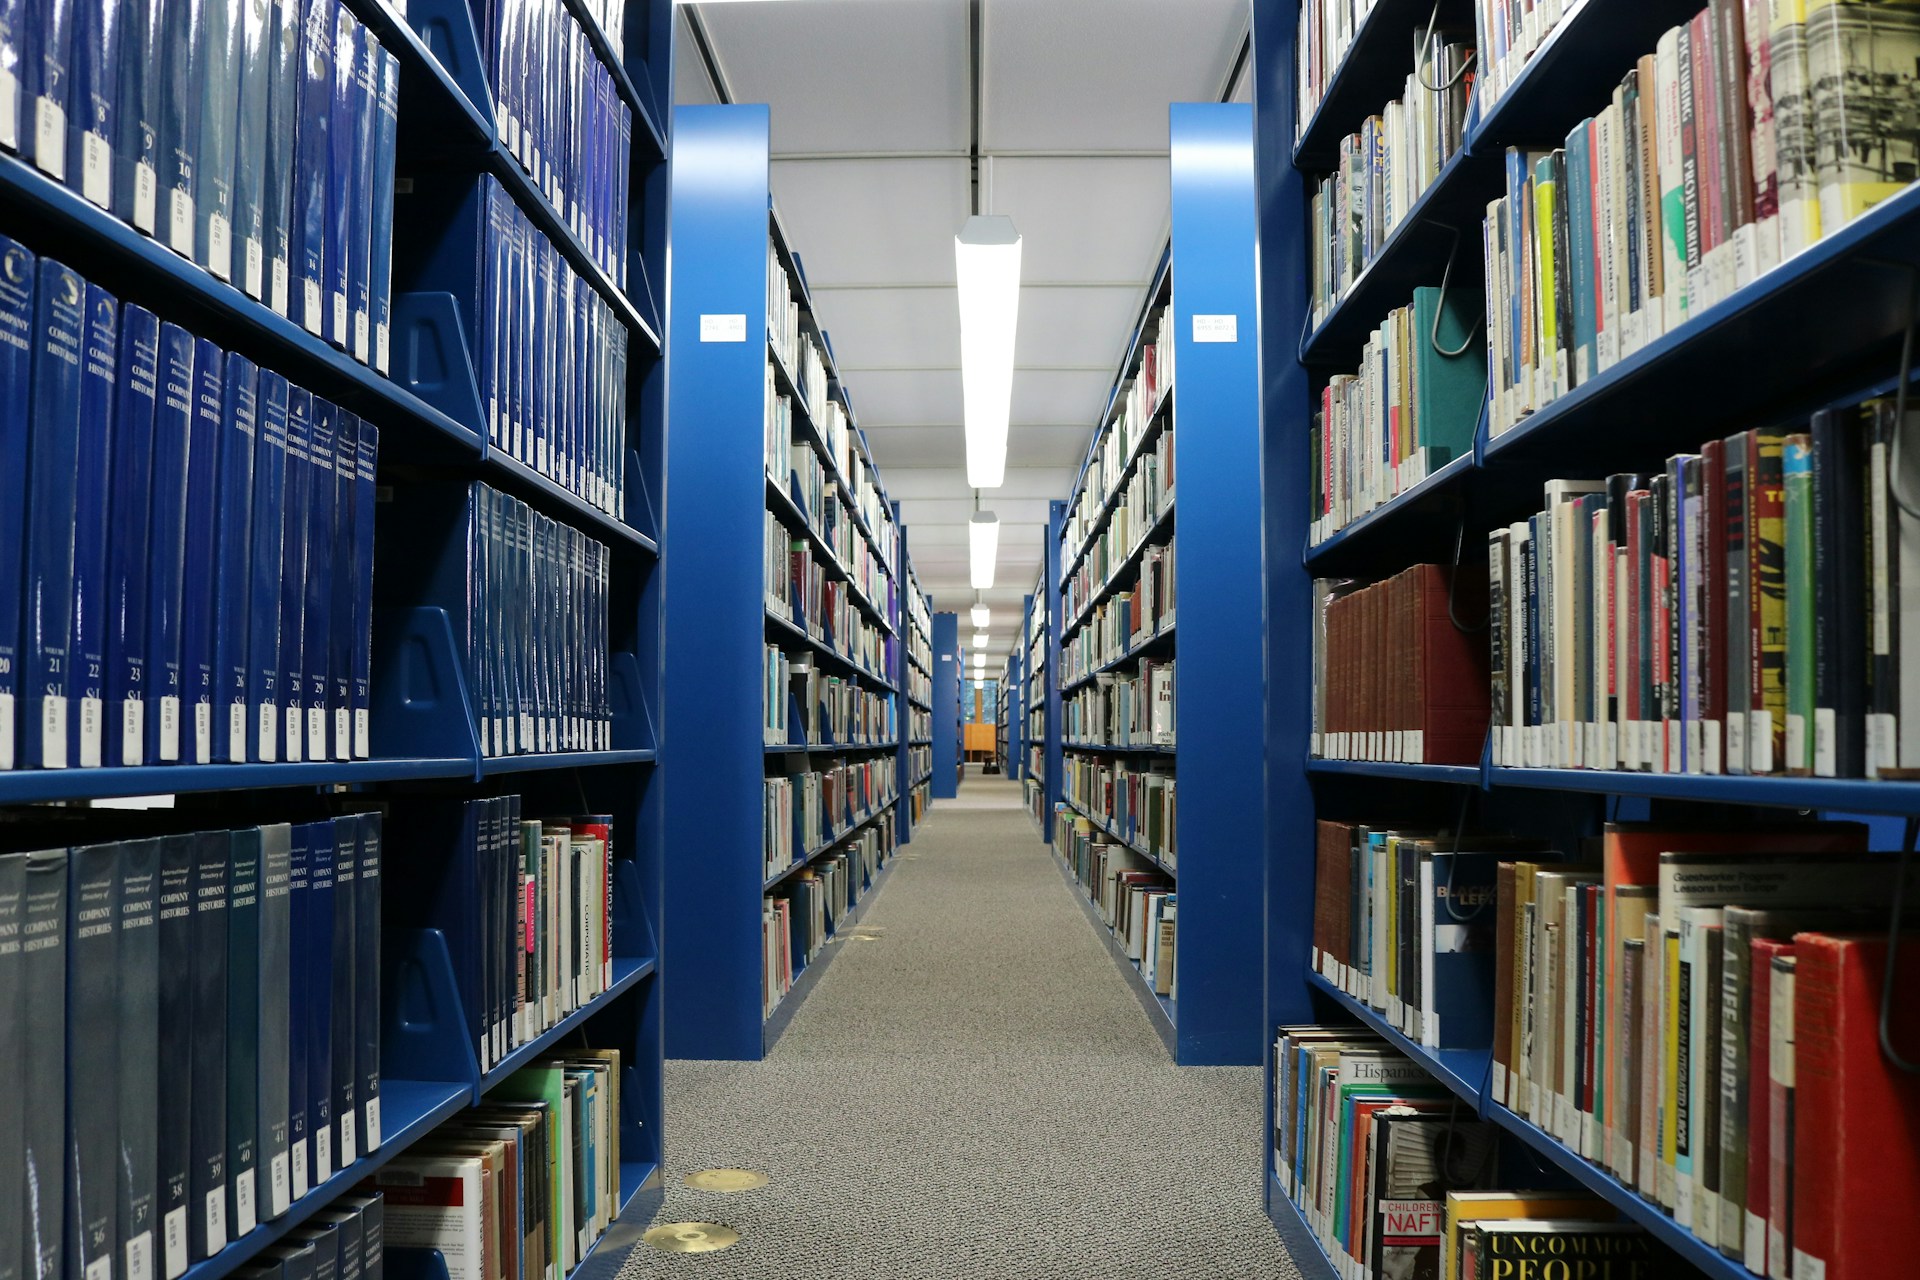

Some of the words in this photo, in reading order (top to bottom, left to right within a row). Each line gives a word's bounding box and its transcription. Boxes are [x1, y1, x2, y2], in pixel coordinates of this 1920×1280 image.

[1679, 33, 1692, 122] PICTURING
[98, 105, 106, 122] 8
[145, 133, 154, 150] 9
[1755, 105, 1770, 194] MACHINE
[178, 162, 191, 179] 10
[1643, 148, 1652, 208] DYNAMICS
[1384, 147, 1392, 227] REUTHER
[218, 191, 227, 206] 11
[253, 213, 261, 228] 12
[1684, 159, 1698, 267] PROLETARIAT
[308, 258, 317, 271] 14
[1647, 229, 1655, 297] DOMINATIO
[360, 289, 367, 302] 16
[49, 326, 79, 348] COMPANY
[47, 342, 79, 365] HISTORIES
[288, 433, 309, 448] COMPANY
[287, 445, 309, 460] HISTORIES
[311, 444, 333, 458] COMPANY
[1751, 548, 1757, 564] OF
[1671, 582, 1679, 629] PEACE
[1672, 633, 1678, 651] IN
[49, 658, 60, 673] 21
[88, 663, 99, 678] 22
[130, 667, 141, 682] 23
[169, 672, 178, 685] 24
[202, 673, 209, 686] 25
[236, 675, 244, 688] 26
[266, 678, 275, 690] 27
[292, 680, 300, 691] 28
[315, 683, 324, 694] 29
[340, 685, 347, 696] 30
[359, 685, 365, 696] 31
[266, 873, 289, 884] COMPANY
[1673, 873, 1736, 882] Guestworker
[198, 885, 226, 897] COMPANY
[233, 882, 256, 894] COMPANY
[265, 886, 290, 898] HISTORIES
[1673, 884, 1715, 892] Lessons
[1717, 884, 1741, 892] from
[1743, 884, 1779, 894] Europe
[160, 891, 189, 905] COMPANY
[198, 899, 226, 912] HISTORIES
[233, 895, 256, 908] HISTORIES
[79, 906, 111, 921] COMPANY
[122, 900, 152, 913] COMPANY
[160, 906, 190, 920] HISTORIES
[24, 918, 59, 934] COMPANY
[78, 922, 112, 938] HISTORIES
[122, 915, 153, 930] HISTORIES
[24, 935, 60, 952] HISTORIES
[1723, 948, 1739, 961] A
[1680, 967, 1689, 999] LABOR
[1721, 971, 1738, 1023] LIFE
[1680, 1001, 1688, 1026] AND
[1679, 1028, 1688, 1043] AN
[1353, 1063, 1425, 1083] Hispanics
[1720, 1028, 1737, 1103] APART
[1678, 1046, 1688, 1107] INTEGRATED
[370, 1078, 377, 1091] 45
[320, 1105, 328, 1118] 43
[294, 1119, 303, 1132] 42
[1677, 1108, 1687, 1149] EUROPE
[275, 1129, 284, 1143] 41
[240, 1148, 251, 1163] 40
[211, 1162, 222, 1179] 39
[172, 1182, 183, 1200] 38
[136, 1204, 148, 1224] 37
[1388, 1203, 1440, 1212] CHILDREN
[1388, 1213, 1441, 1232] NAFT
[93, 1226, 105, 1248] 36
[1491, 1232, 1651, 1255] UNCOMMON
[1491, 1258, 1650, 1280] PEOPLE
